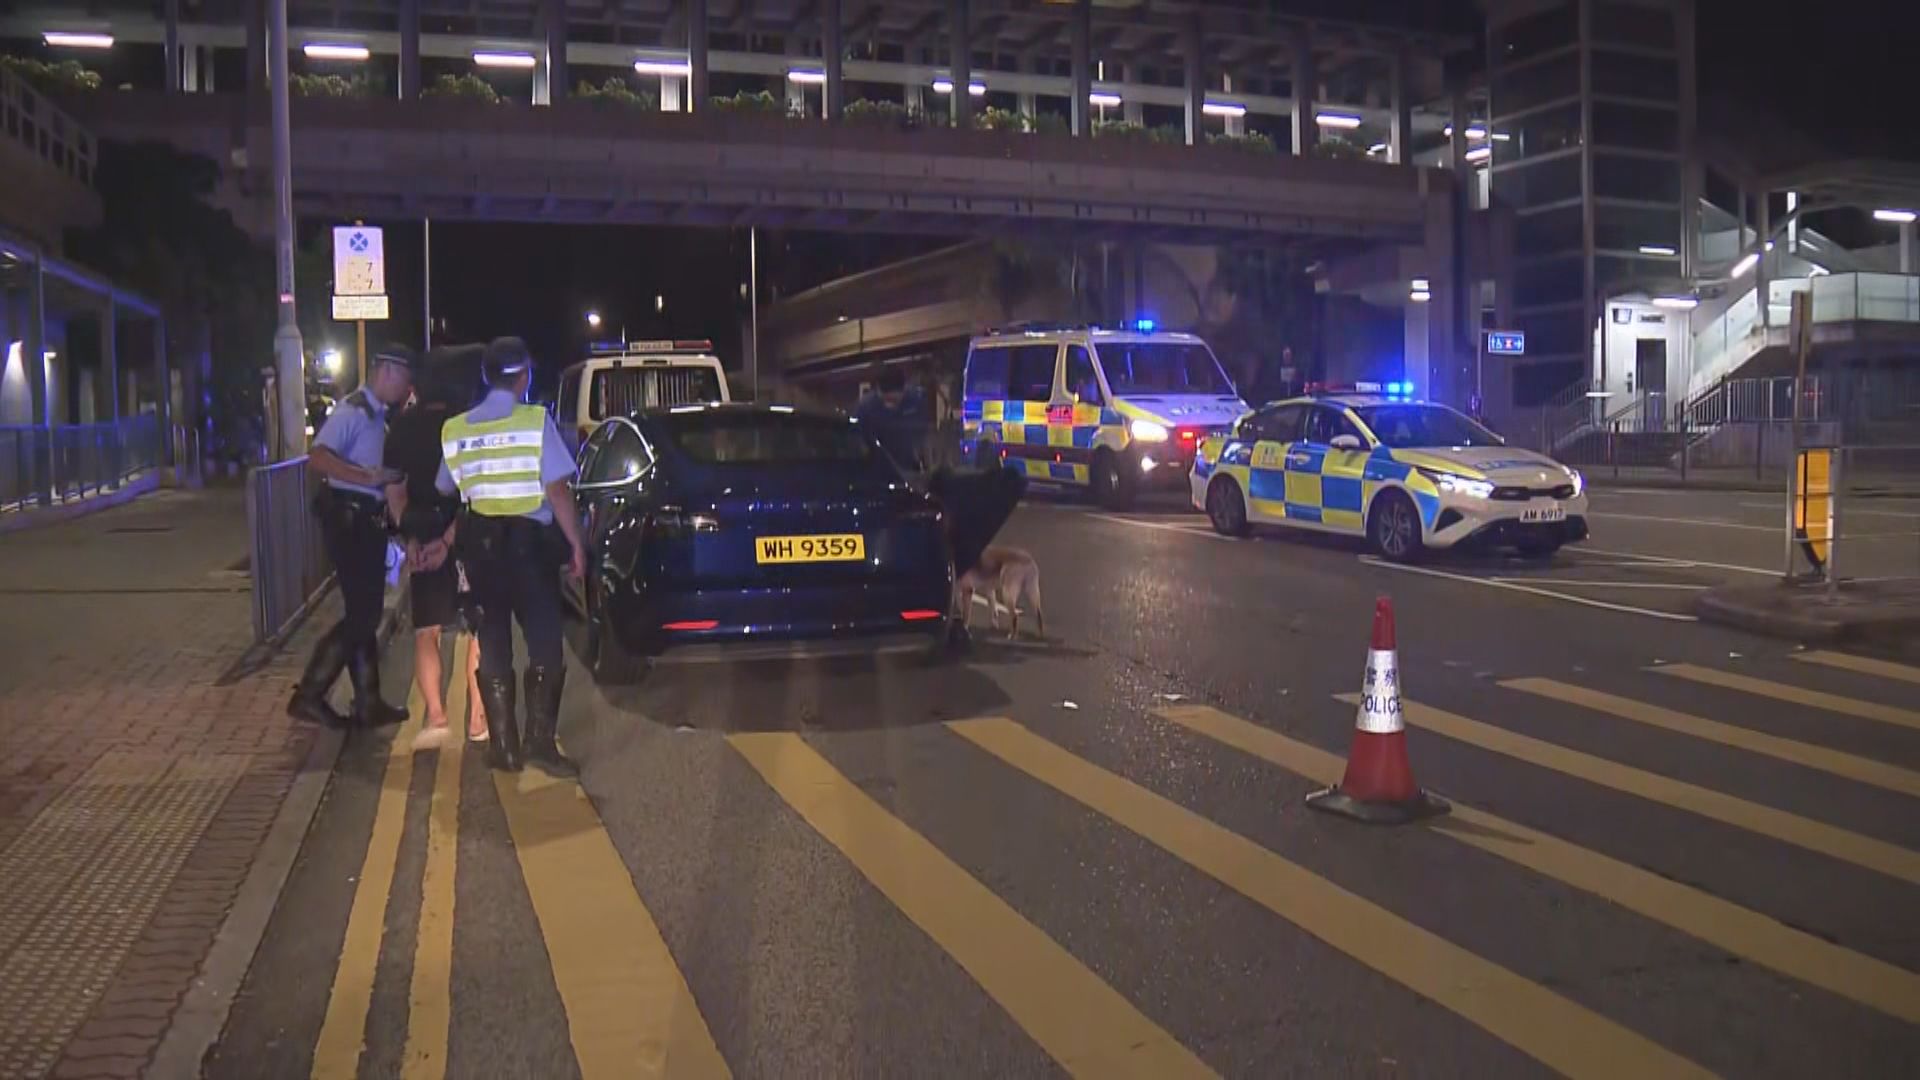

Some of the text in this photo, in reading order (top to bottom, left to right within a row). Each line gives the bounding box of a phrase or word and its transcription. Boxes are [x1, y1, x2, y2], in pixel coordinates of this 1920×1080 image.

[1523, 510, 1537, 520] AM
[764, 538, 857, 558] WH 9359
[1361, 692, 1402, 715] POLICE
